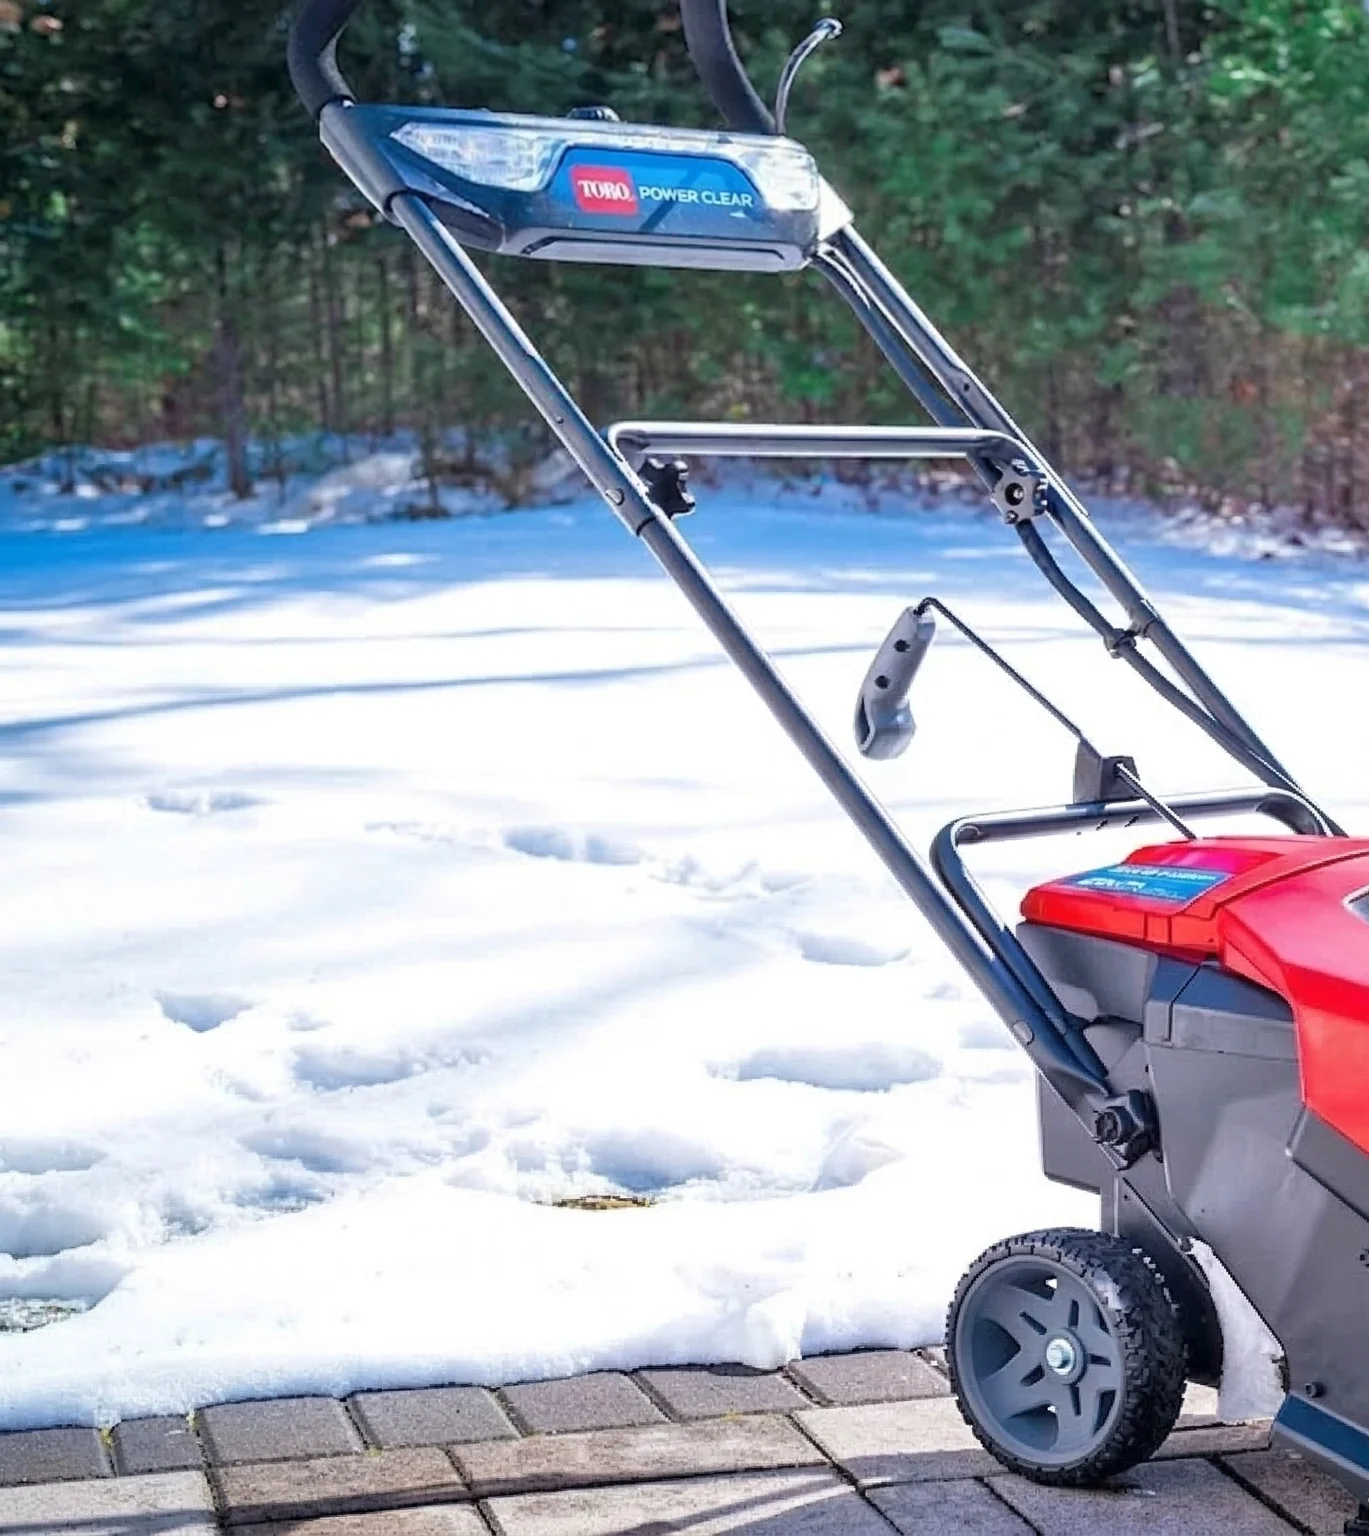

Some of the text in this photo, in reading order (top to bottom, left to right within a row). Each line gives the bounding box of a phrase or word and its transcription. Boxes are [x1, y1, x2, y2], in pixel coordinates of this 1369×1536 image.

[577, 180, 633, 201] TORO
[638, 185, 753, 208] POWER CLEAR
